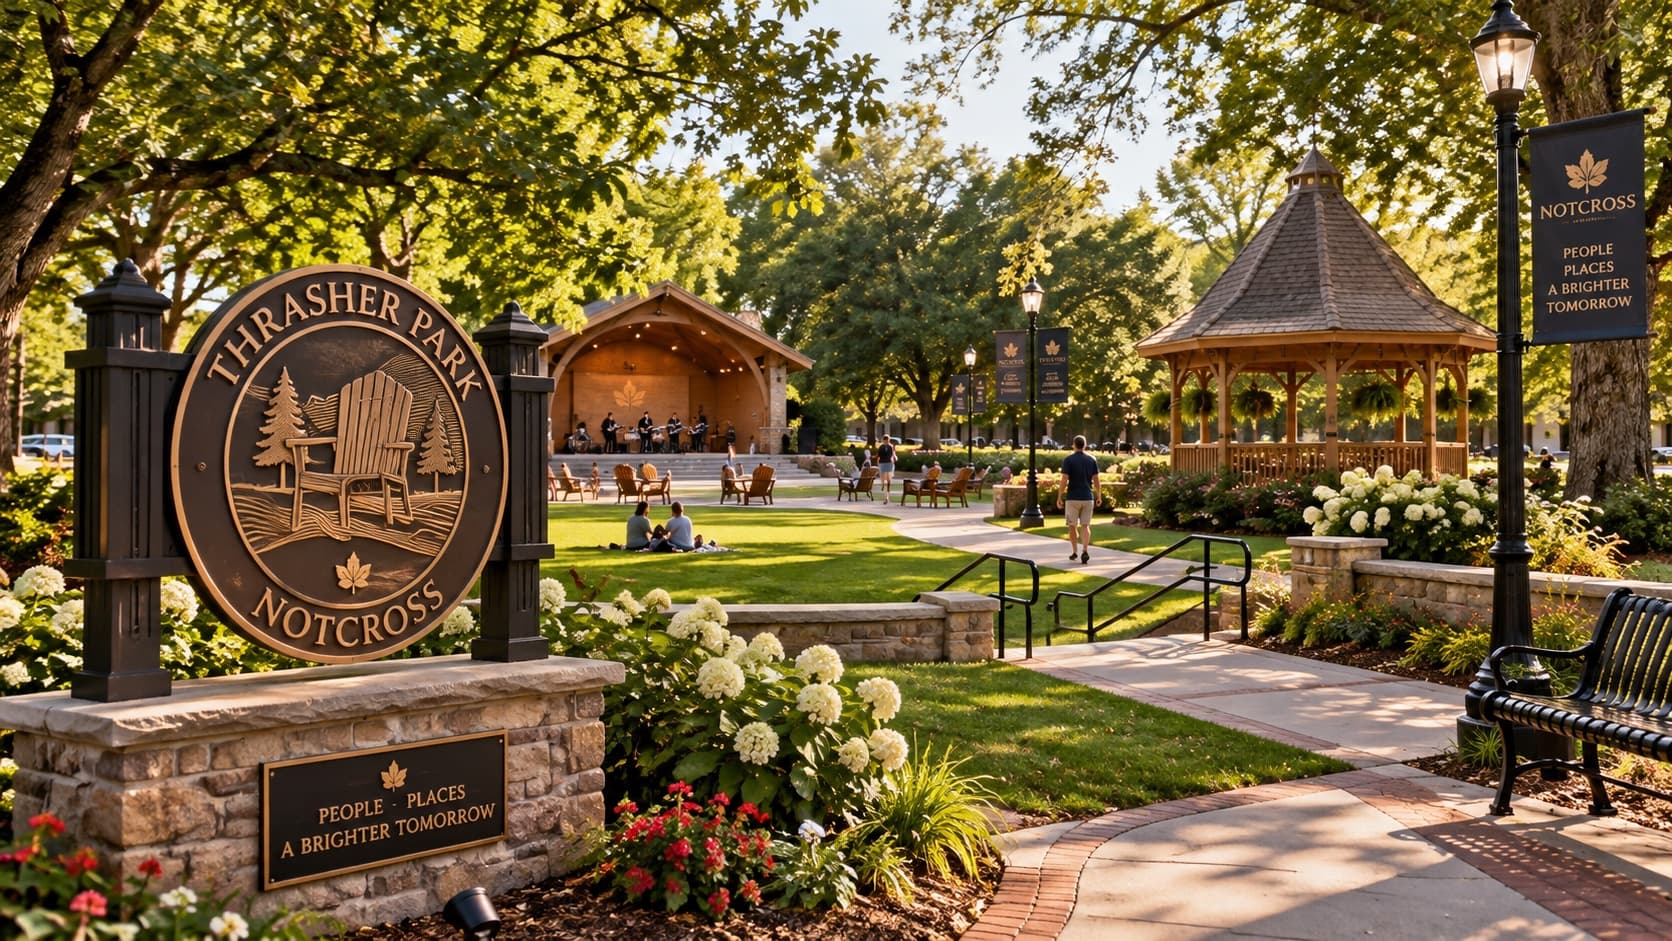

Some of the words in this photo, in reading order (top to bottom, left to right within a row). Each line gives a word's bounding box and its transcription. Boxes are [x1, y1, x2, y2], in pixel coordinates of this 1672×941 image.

[1540, 193, 1636, 220] NOTCROSS
[1563, 243, 1614, 259] PEOPLE
[1564, 260, 1614, 277] PLACES
[1548, 284, 1558, 296] A
[1561, 277, 1630, 295] BRIGHTER
[1546, 295, 1632, 314] TOMORROW
[206, 281, 401, 386] THRASHER
[407, 307, 482, 401] PARK
[251, 578, 444, 648] NOTCROSS
[318, 798, 384, 824] PEOPLE
[407, 784, 466, 809] PLACES
[280, 840, 294, 859] A
[300, 823, 391, 855] BRIGHTER
[395, 803, 496, 836] TOMORROW
